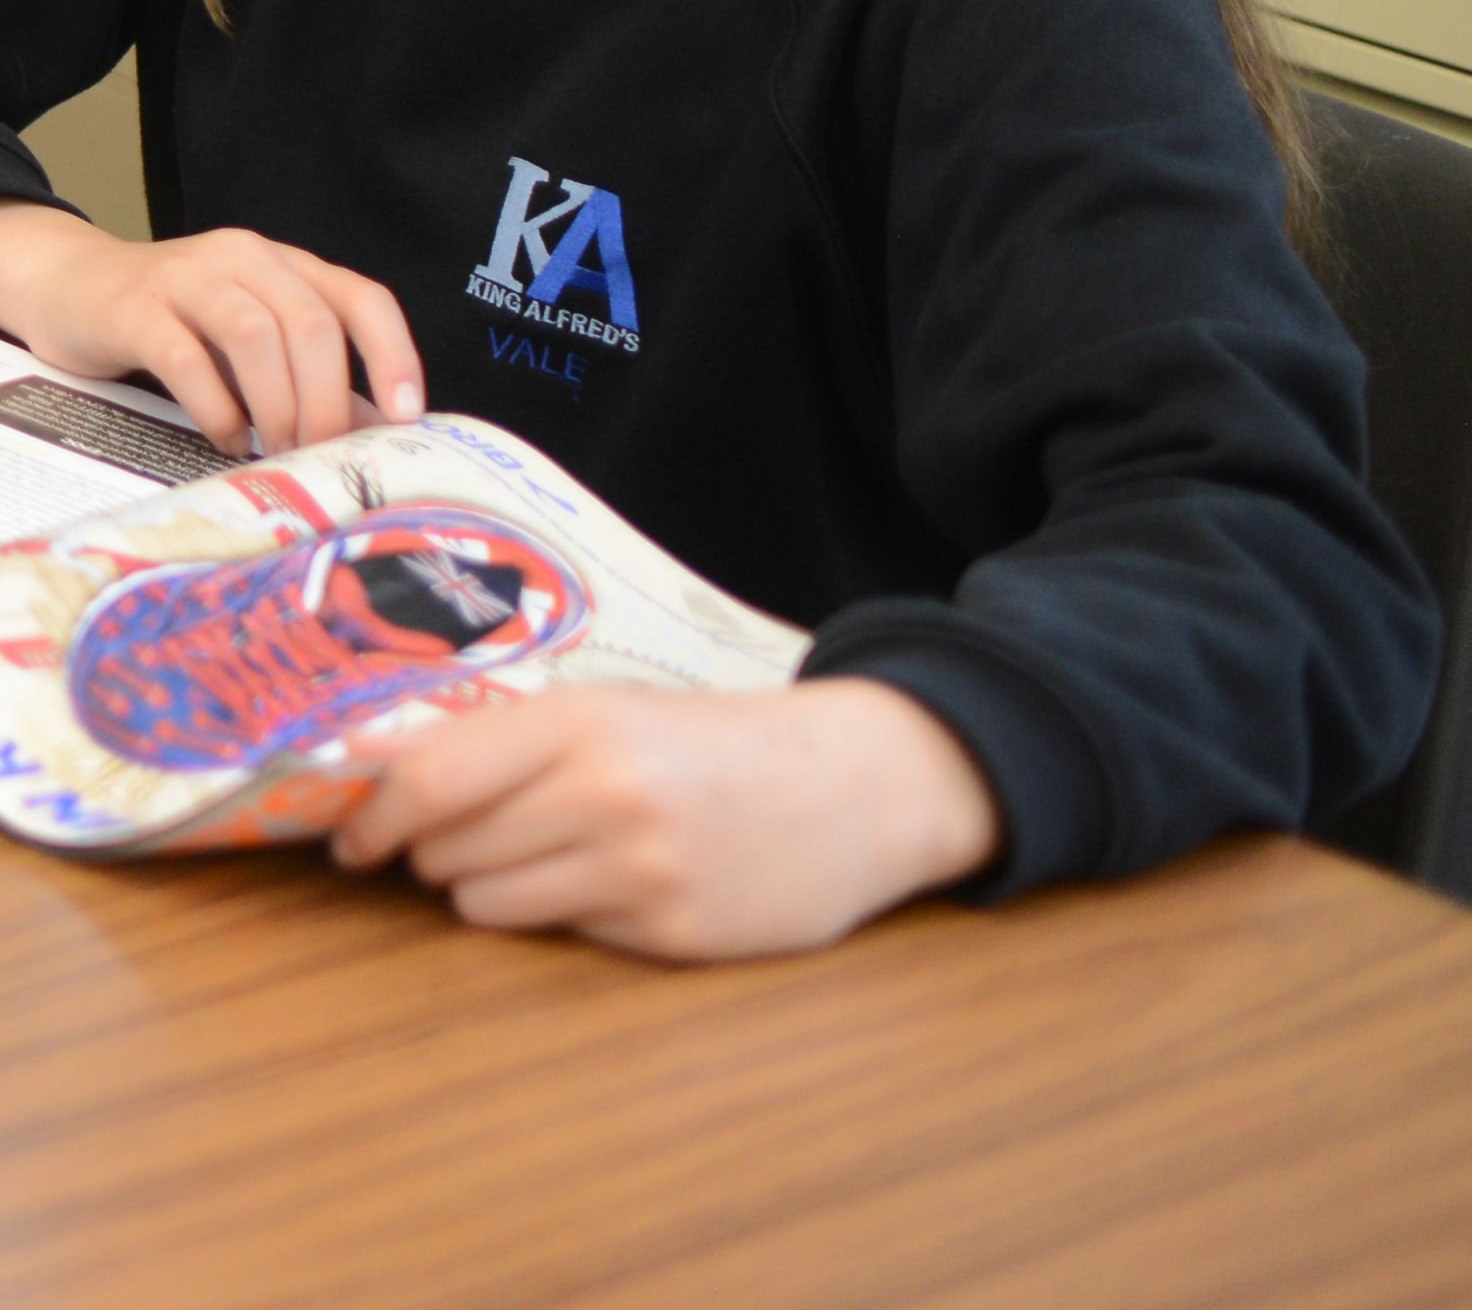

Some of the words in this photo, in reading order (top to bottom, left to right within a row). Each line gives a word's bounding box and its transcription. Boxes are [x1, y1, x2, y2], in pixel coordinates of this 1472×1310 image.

[474, 155, 640, 332] KA
[465, 273, 522, 314] KING
[523, 299, 642, 353] ALFRED'S
[488, 325, 591, 384] VALE
[24, 786, 130, 832] IN
